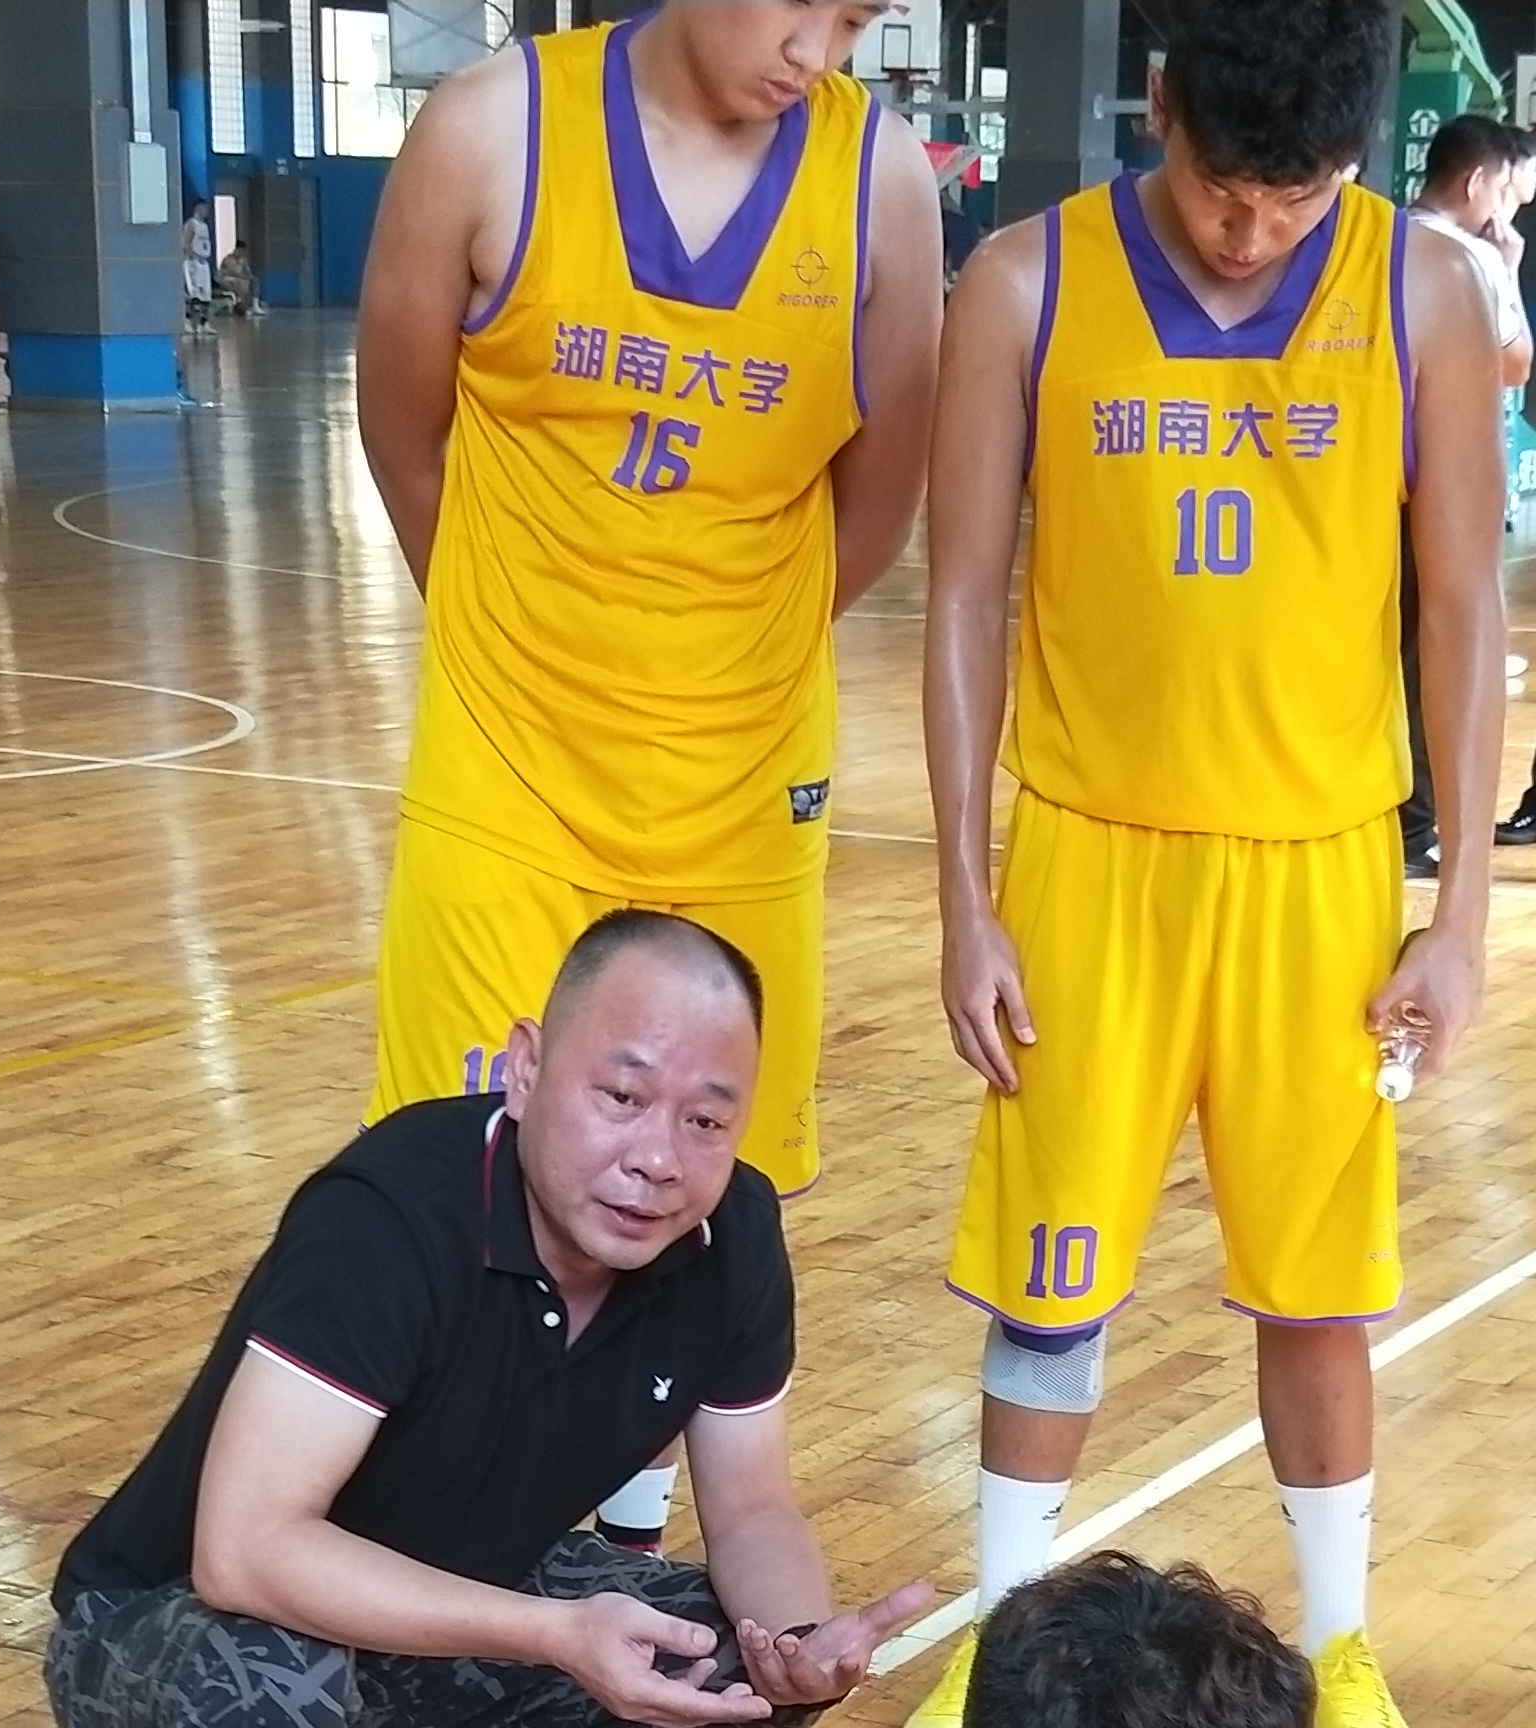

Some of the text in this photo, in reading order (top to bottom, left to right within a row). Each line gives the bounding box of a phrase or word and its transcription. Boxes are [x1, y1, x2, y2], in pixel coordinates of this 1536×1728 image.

[550, 321, 790, 414] 湖南大学
[611, 410, 701, 495] 16
[1092, 399, 1340, 459] 湖南大学
[1173, 487, 1253, 576] 10
[1025, 1221, 1099, 1300] 10
